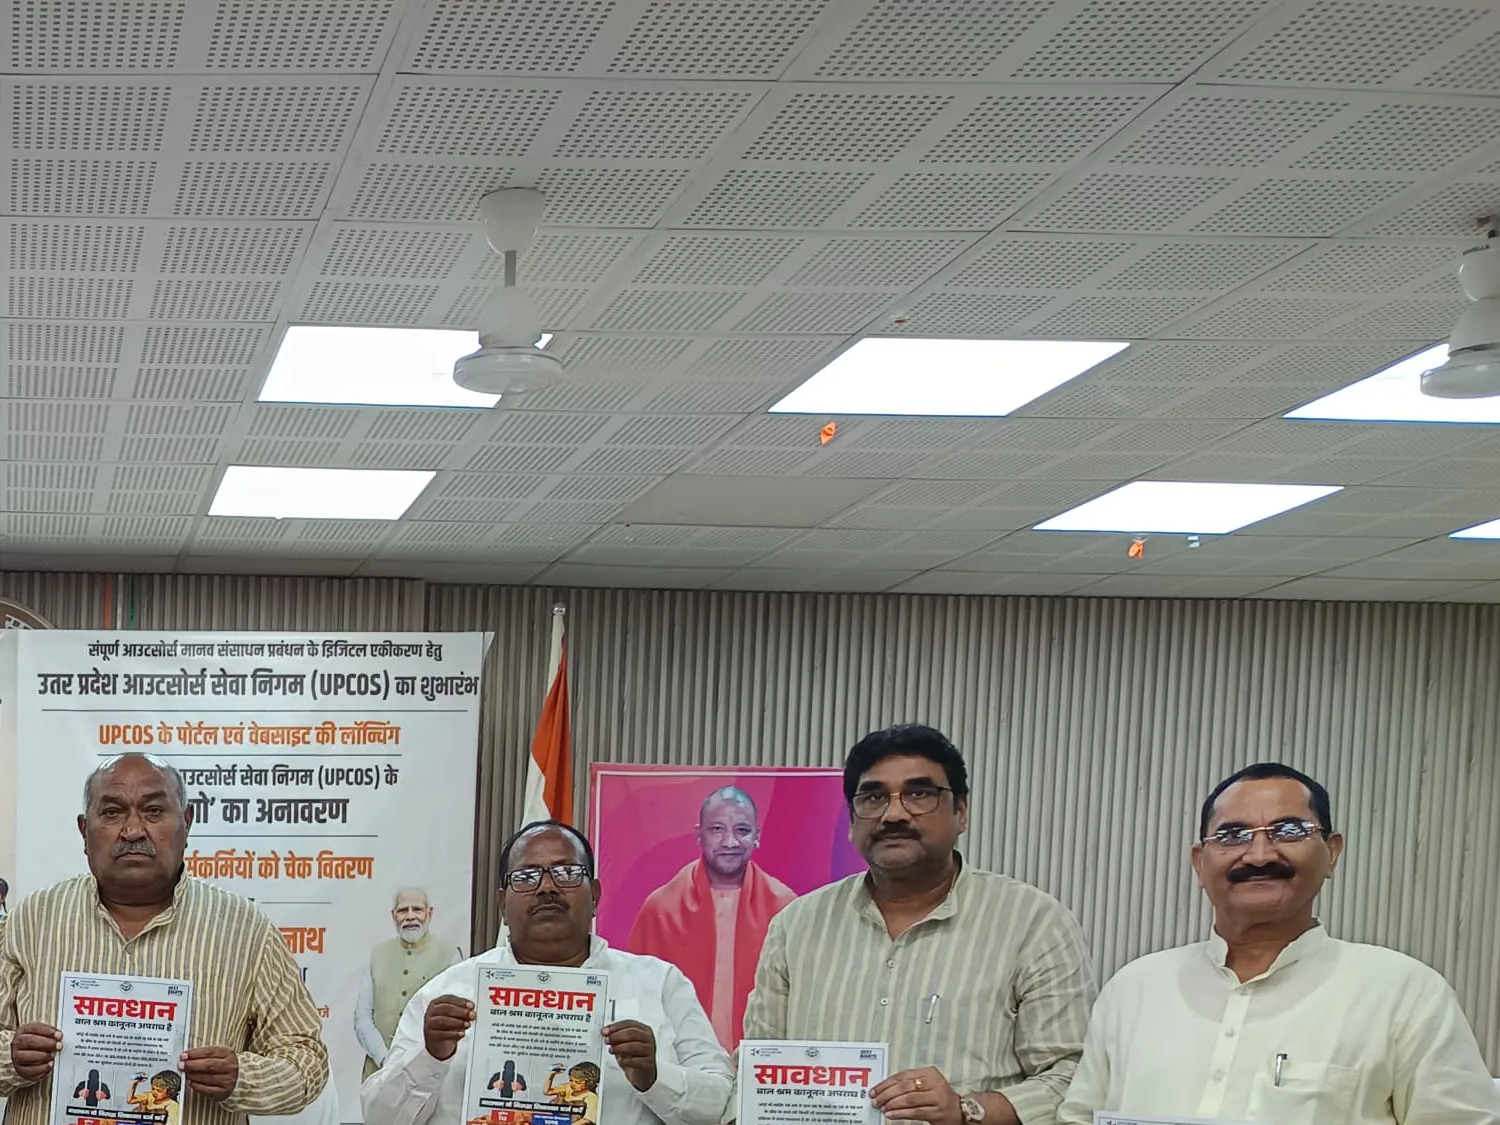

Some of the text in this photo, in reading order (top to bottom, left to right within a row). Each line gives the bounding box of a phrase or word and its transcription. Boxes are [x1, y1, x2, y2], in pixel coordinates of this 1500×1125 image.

[88, 640, 120, 661] संपूर्ण
[122, 640, 178, 657] आउटसोर्स
[180, 643, 214, 657] मानव
[217, 640, 265, 657] संसाधन
[268, 640, 304, 657] प्रबंधन
[307, 640, 319, 657] के
[370, 640, 423, 657] एकीकरण
[425, 640, 443, 661] हेतु
[78, 667, 118, 695] प्रदेश
[122, 667, 207, 696] आउटसोर्स
[210, 668, 248, 696] सेवा
[251, 668, 306, 696] निगम
[311, 669, 390, 700] (UPCOS)
[395, 675, 417, 696] का
[420, 671, 480, 701] शुभारंभ
[100, 720, 401, 747] UPCOS के पोर्टल एवं वेबसाइट की लॉन्चिंग
[239, 764, 268, 786] सेवा
[272, 764, 314, 786] निगम
[318, 765, 380, 790] (UPCOS)
[383, 764, 399, 786] के
[221, 798, 250, 824] का
[255, 798, 349, 824] अनावरण
[257, 851, 282, 880] को
[284, 851, 314, 880] चेक
[316, 851, 375, 880] वितरण
[73, 995, 177, 1021] सावधान
[488, 986, 596, 1012] सावधान
[753, 1064, 871, 1088] सावधान
